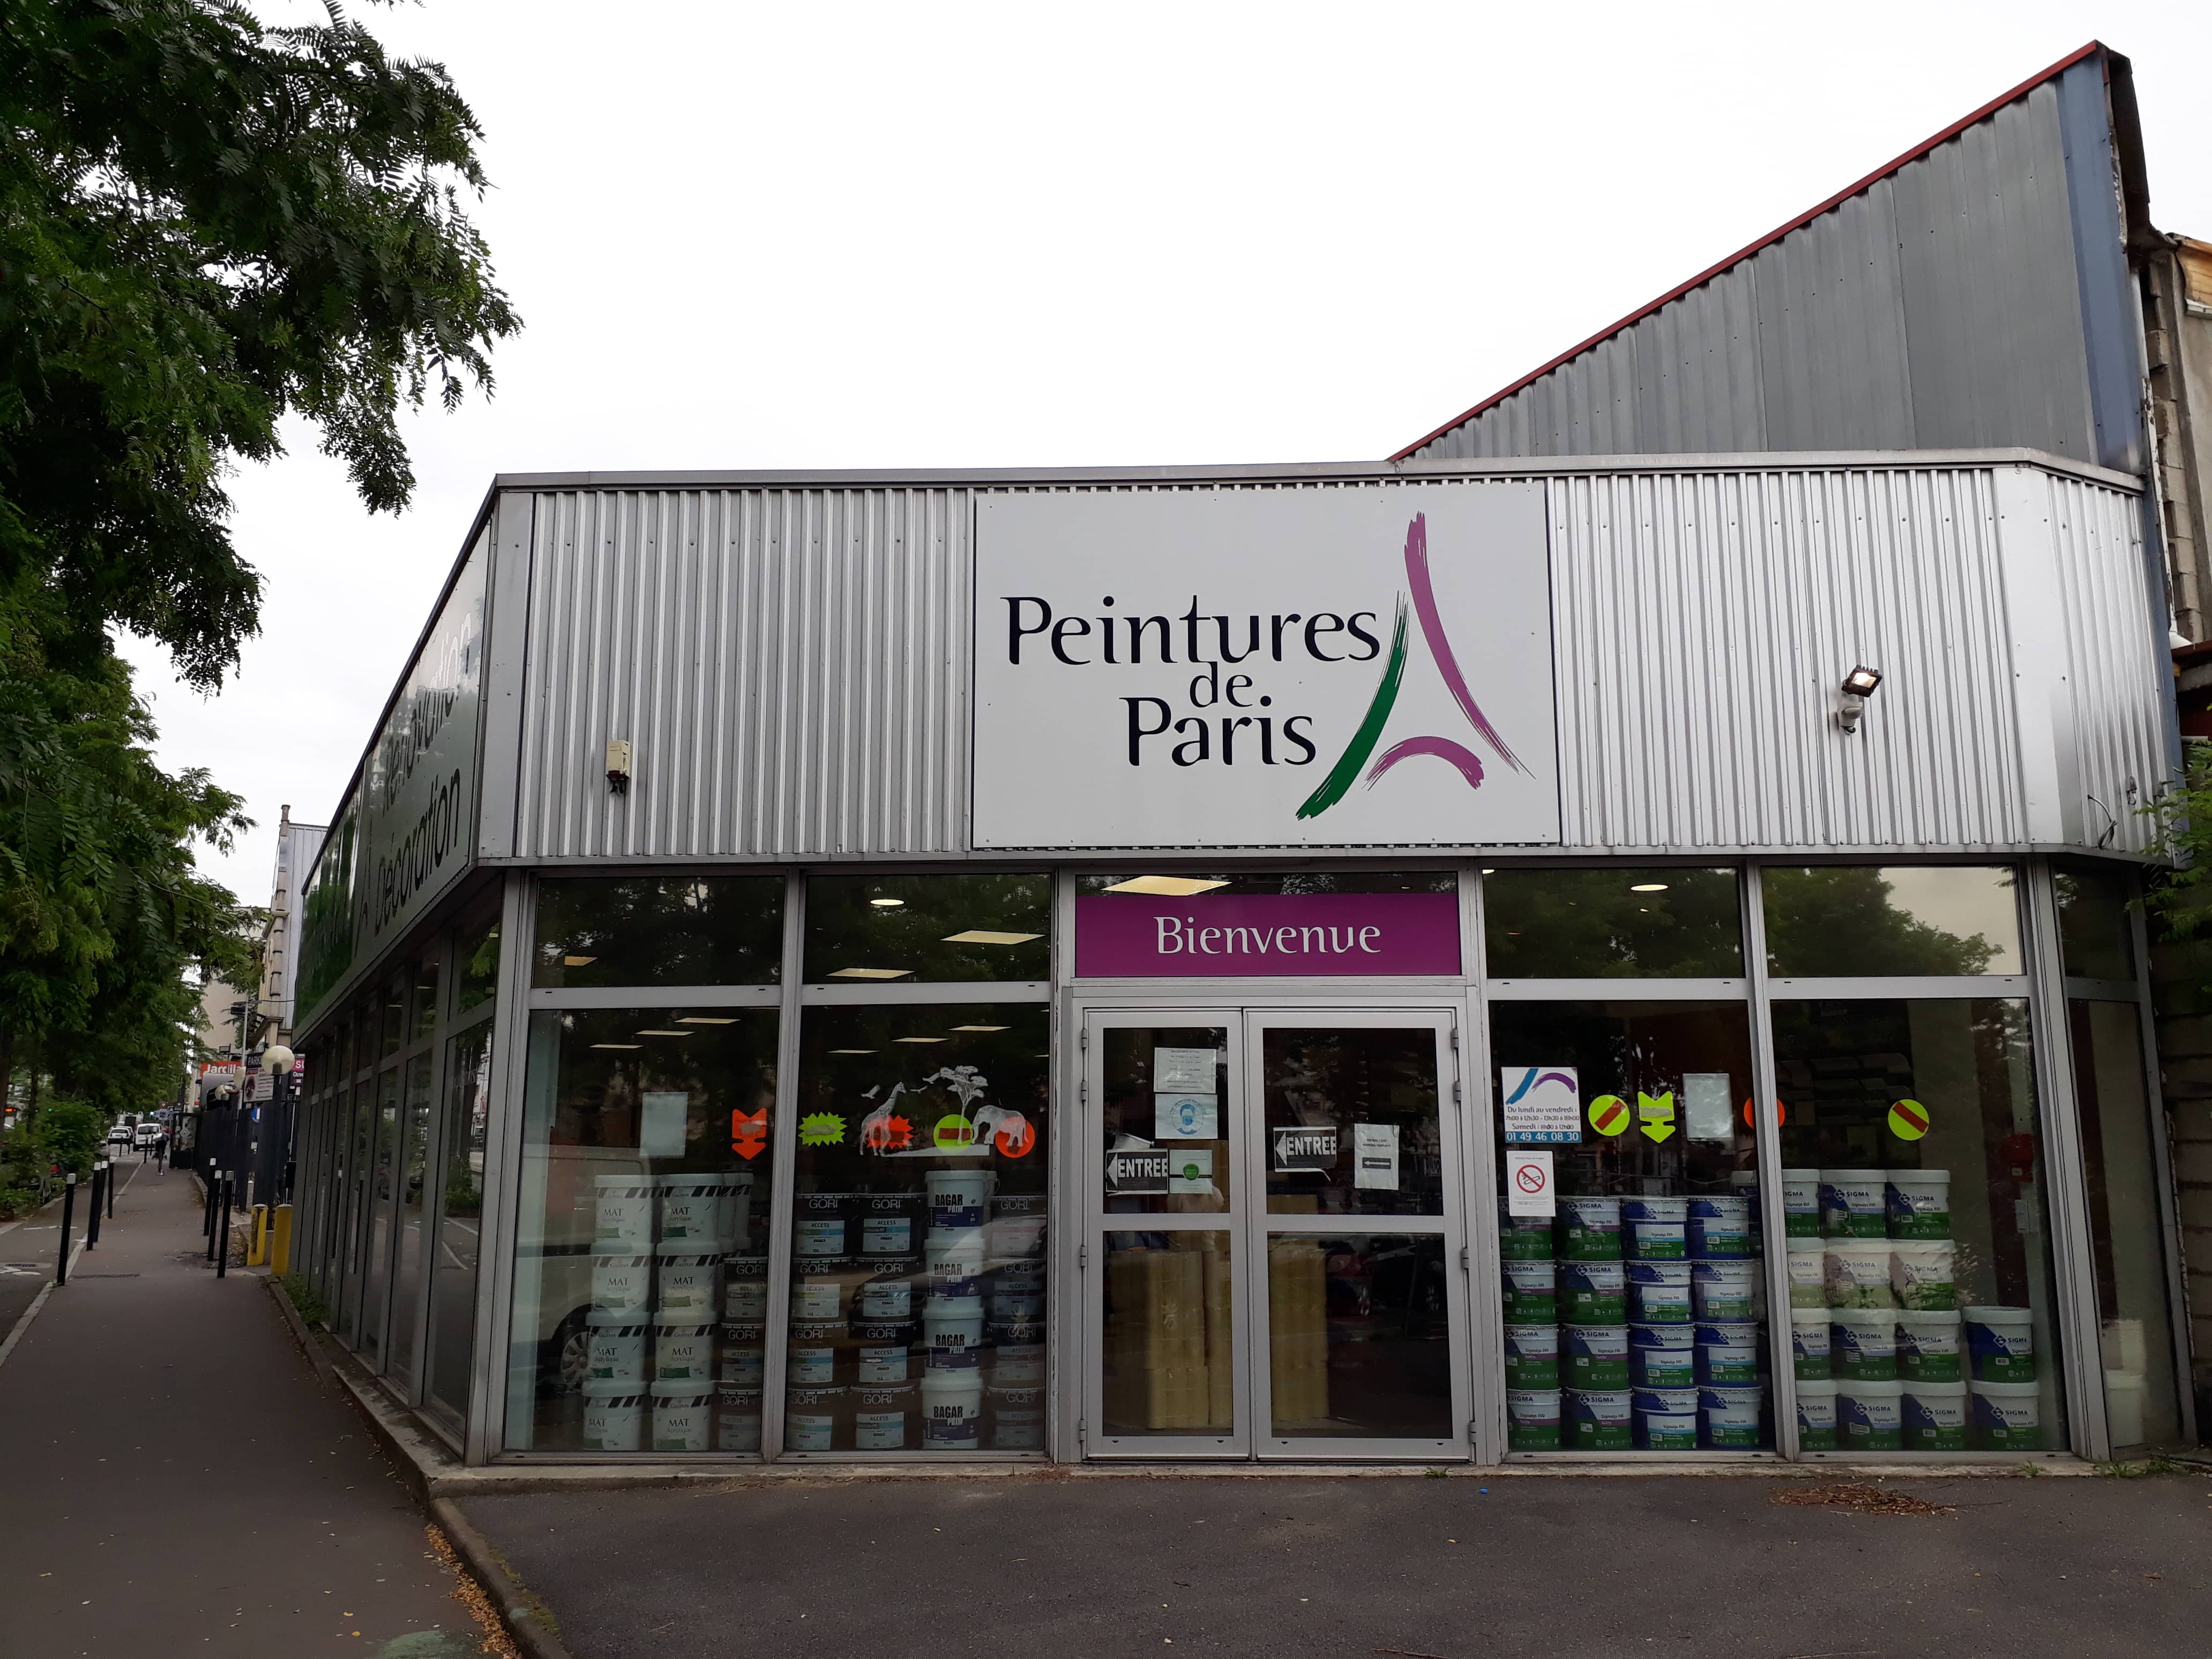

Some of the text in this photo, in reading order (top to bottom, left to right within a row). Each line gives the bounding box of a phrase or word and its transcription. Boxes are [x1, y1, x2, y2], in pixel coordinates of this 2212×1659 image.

[1000, 595, 1380, 666] Peintures
[1190, 661, 1254, 708] de
[1118, 695, 1317, 767] Paris
[1153, 916, 1381, 954] Bienvenue
[1506, 1132, 1579, 1141] 01 49 46 08 30
[1287, 1136, 1336, 1156] ENTREE
[1118, 1158, 1167, 1178] ENTREE
[809, 1199, 838, 1208] GORI
[872, 1199, 901, 1209] GORI
[935, 1194, 963, 1206] BAGAR
[604, 1208, 623, 1216] MAT
[670, 1207, 690, 1215] MAT
[800, 1264, 828, 1273] GORI
[875, 1263, 904, 1273] GORI
[935, 1264, 962, 1276] BAGAR
[608, 1277, 629, 1286] MAT
[674, 1276, 694, 1284] MAT
[728, 1330, 756, 1340] GORI
[795, 1329, 823, 1339] GORI
[867, 1328, 896, 1339] GORI
[936, 1334, 965, 1347] BAGAR
[596, 1347, 617, 1356] MAT
[672, 1347, 693, 1355] MAT
[723, 1395, 749, 1406] GORI
[863, 1394, 892, 1404] GORI
[933, 1406, 963, 1418] BAGAR
[589, 1418, 607, 1426] MAT
[669, 1418, 690, 1426] MAT
